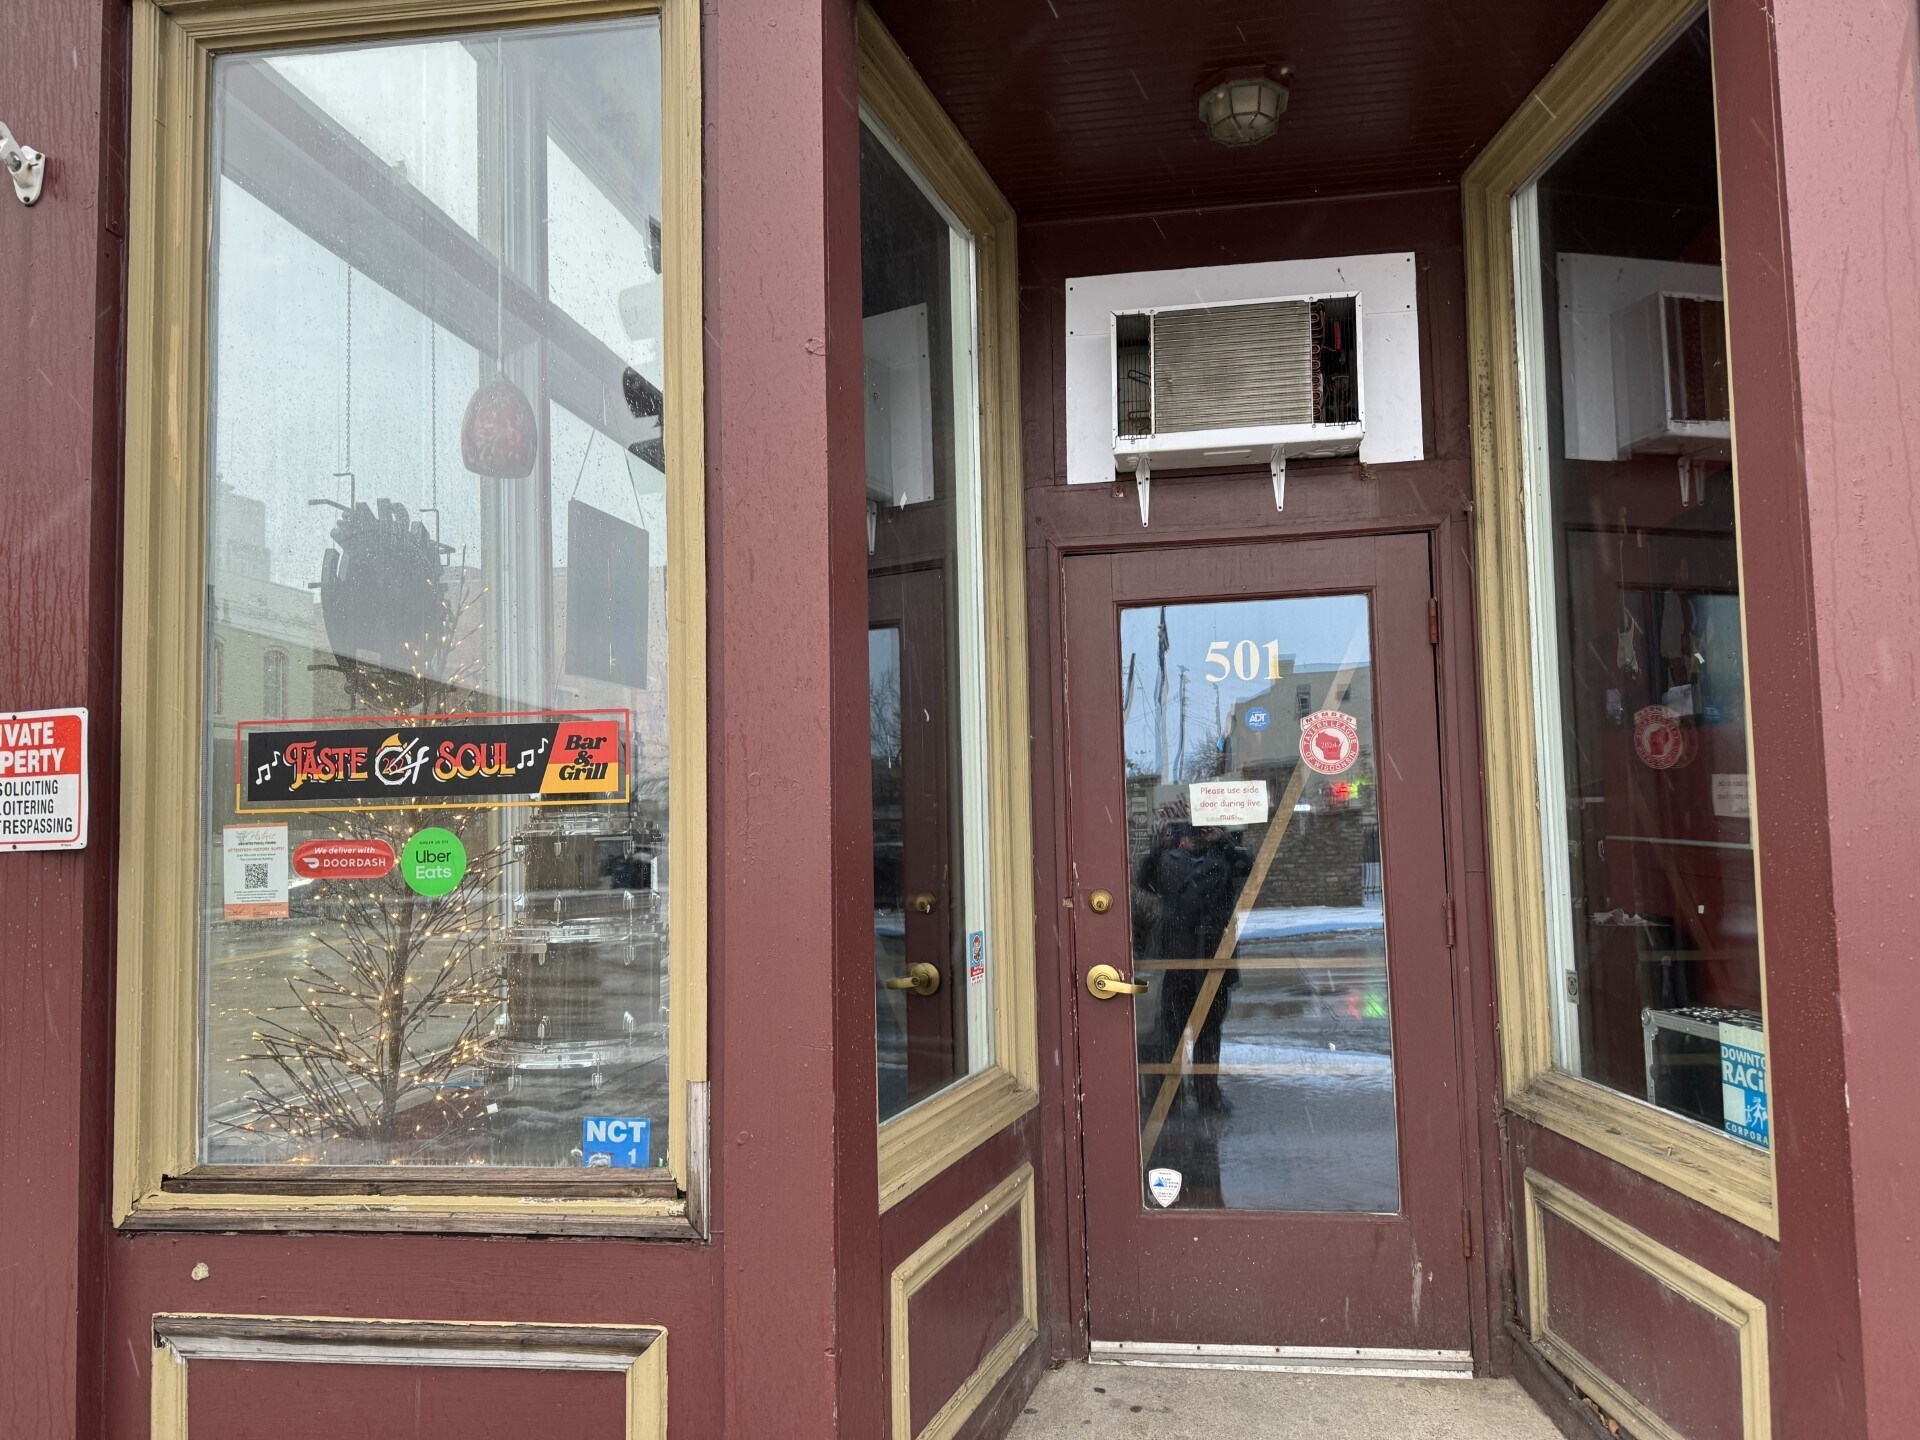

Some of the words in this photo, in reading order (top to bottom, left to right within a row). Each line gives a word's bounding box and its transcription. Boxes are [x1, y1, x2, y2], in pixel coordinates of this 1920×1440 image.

[1205, 639, 1283, 682] 501
[1249, 713, 1266, 722] ADT
[1306, 711, 1352, 723] MEMBER
[1303, 720, 1328, 745] TAVERN
[1330, 720, 1356, 744] LEAGUE
[565, 734, 607, 750] Bar
[1320, 741, 1337, 749] 2024
[283, 741, 368, 791] TASTE
[432, 741, 516, 782] SOUL
[573, 751, 593, 767] &
[559, 762, 608, 781] Grill
[1200, 787, 1225, 795] Please
[1243, 786, 1259, 794] side
[0, 799, 54, 816] OITERING
[1200, 800, 1216, 808] door
[1220, 800, 1245, 809] during
[0, 817, 73, 834] RESPASSING
[323, 857, 386, 868] DOORDASH
[415, 850, 452, 864] Uber
[415, 865, 452, 880] Eats
[586, 1120, 646, 1143] NCT
[628, 1148, 636, 1164] 1
